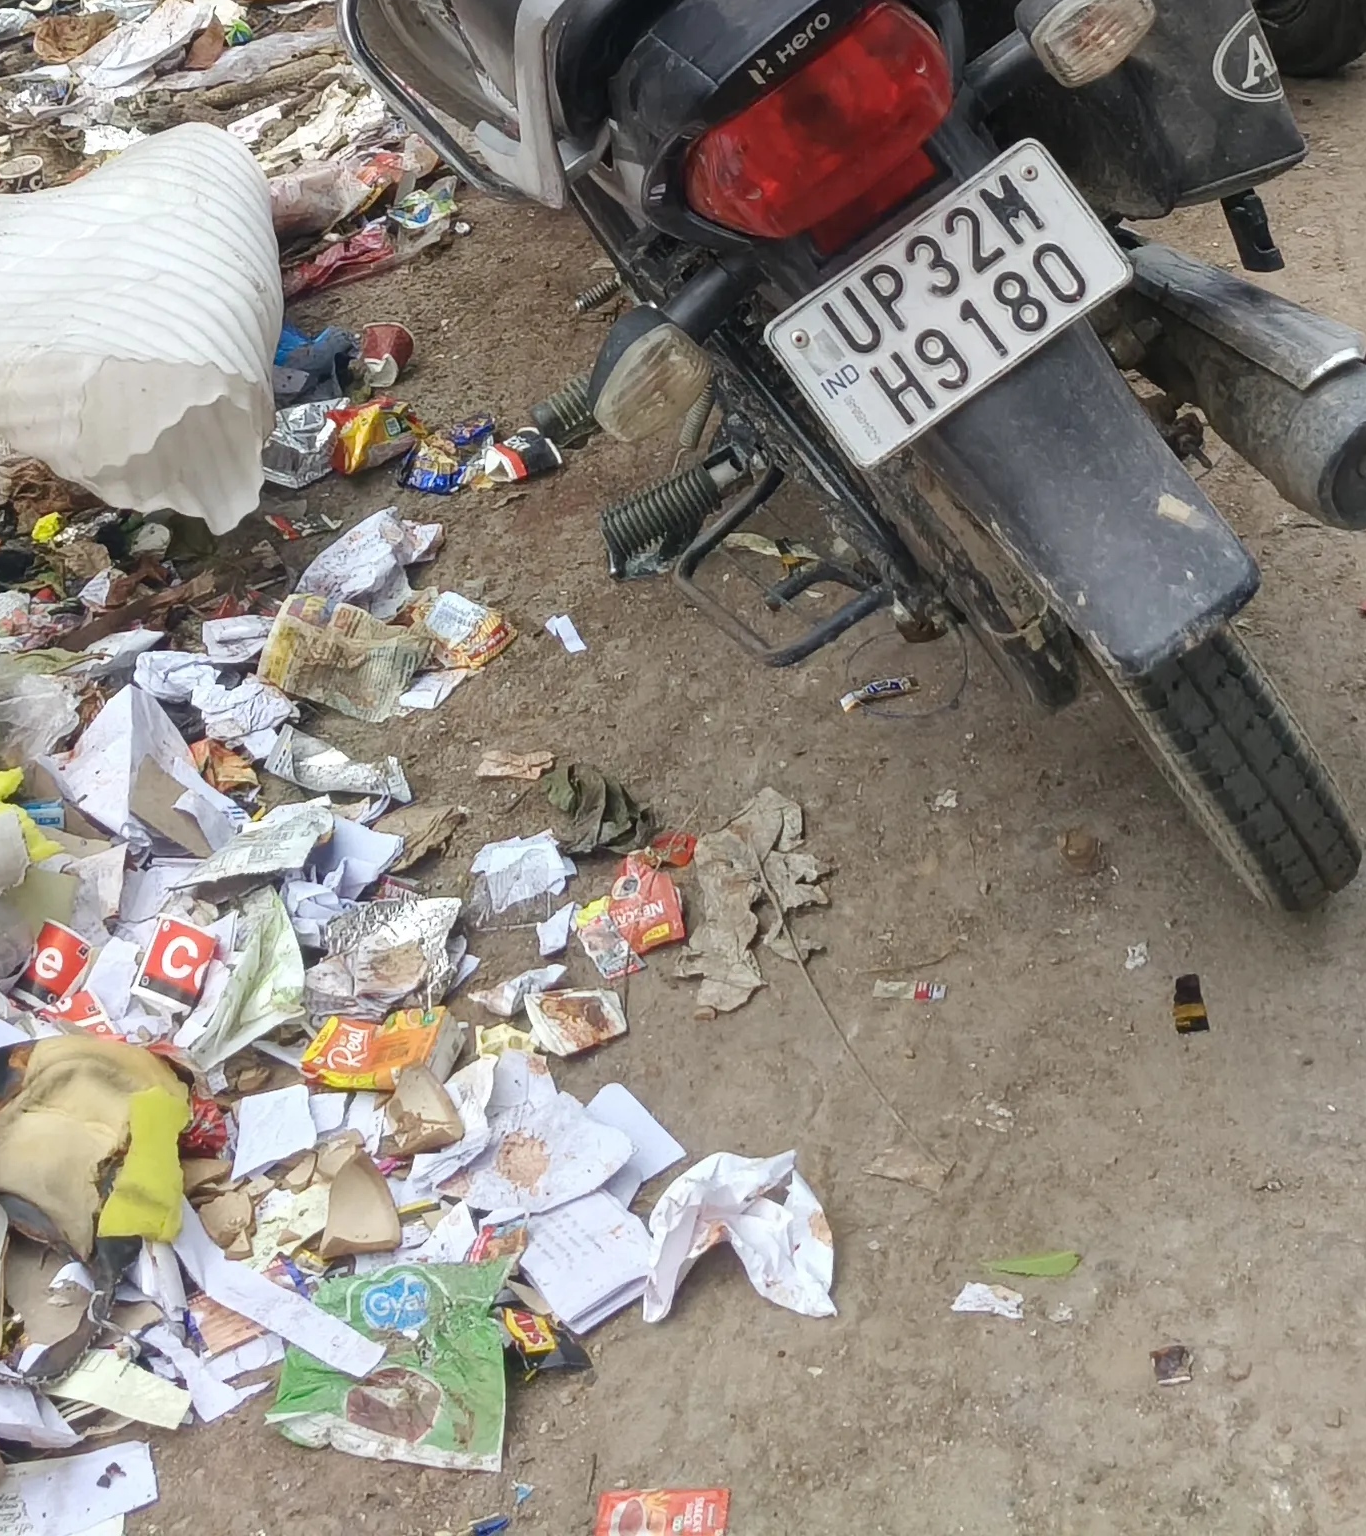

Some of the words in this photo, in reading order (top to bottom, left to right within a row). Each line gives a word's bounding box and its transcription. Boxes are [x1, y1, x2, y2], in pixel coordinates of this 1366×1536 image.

[776, 12, 831, 64] Hero
[821, 173, 1045, 355] UP32M
[869, 242, 1087, 427] H9180
[820, 363, 861, 400] IND
[326, 1022, 372, 1070] Real
